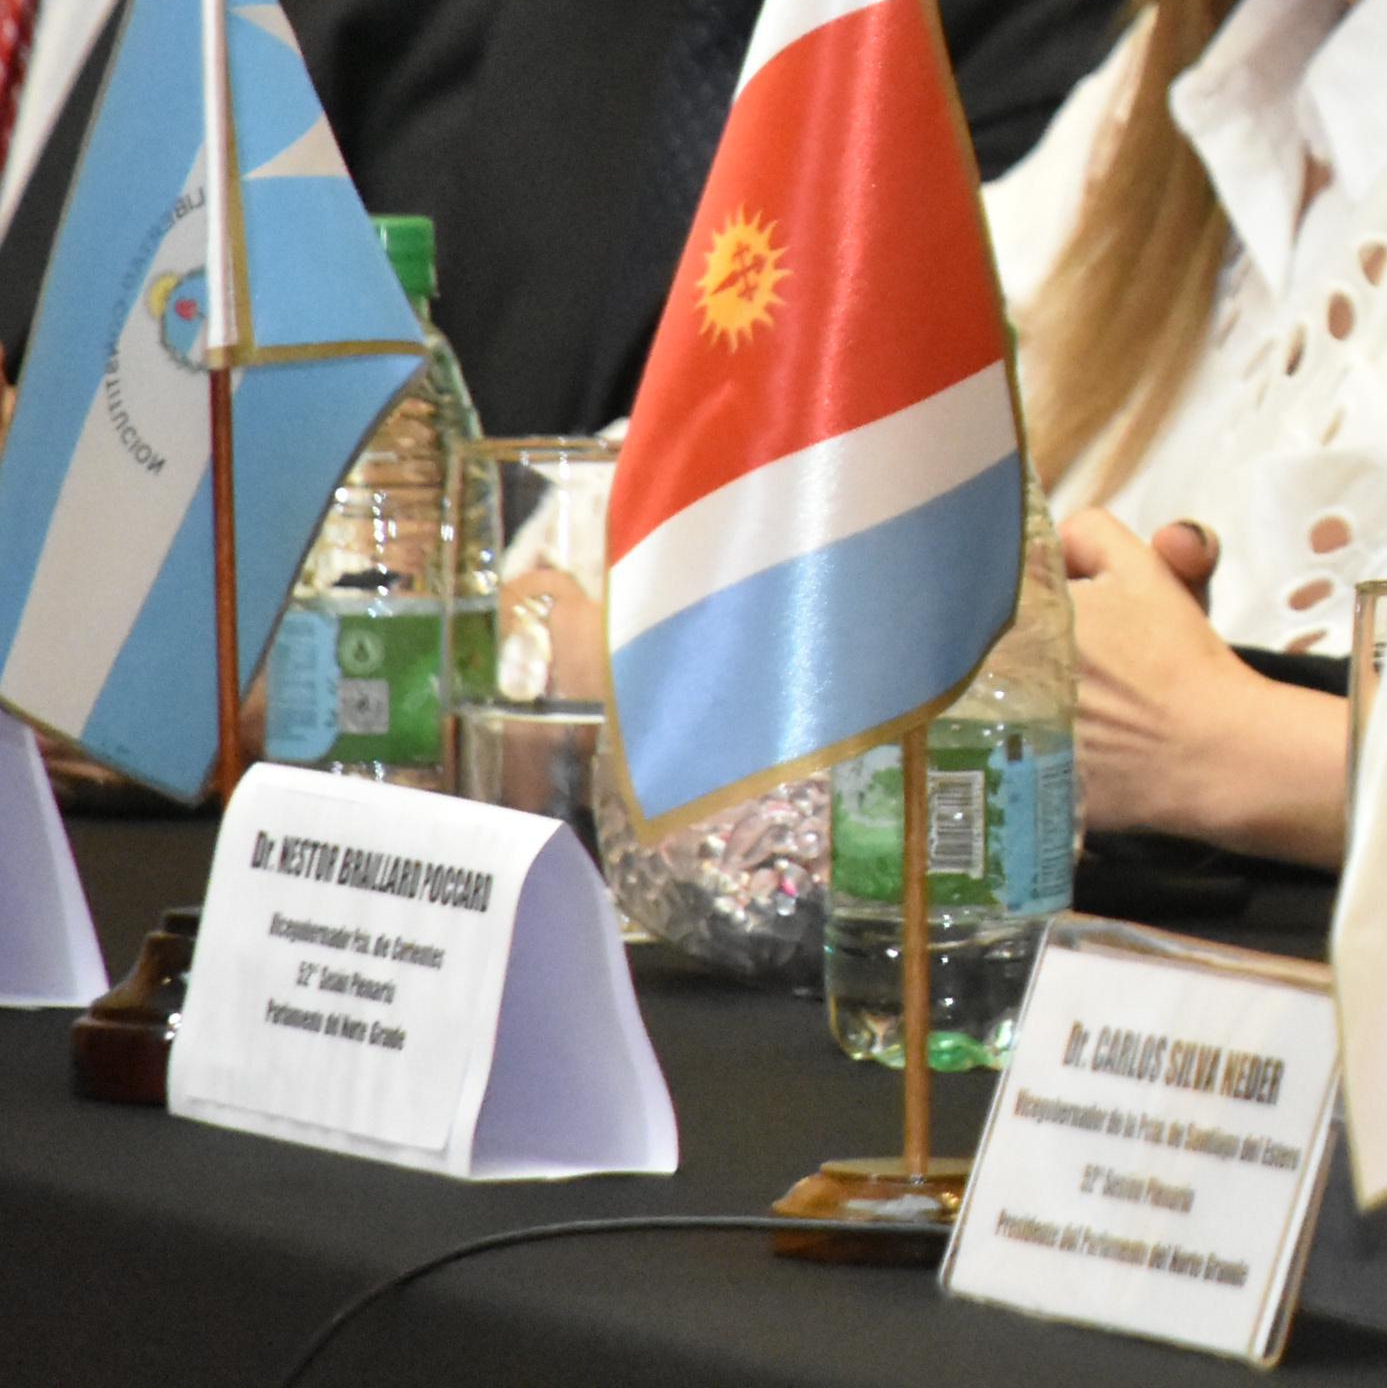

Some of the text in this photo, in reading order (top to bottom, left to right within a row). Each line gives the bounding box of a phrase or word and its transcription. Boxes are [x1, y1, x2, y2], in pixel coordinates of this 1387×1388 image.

[278, 835, 339, 882] NESTOR
[1062, 1020, 1285, 1105] Dr. CARLOS SILVA NEDER
